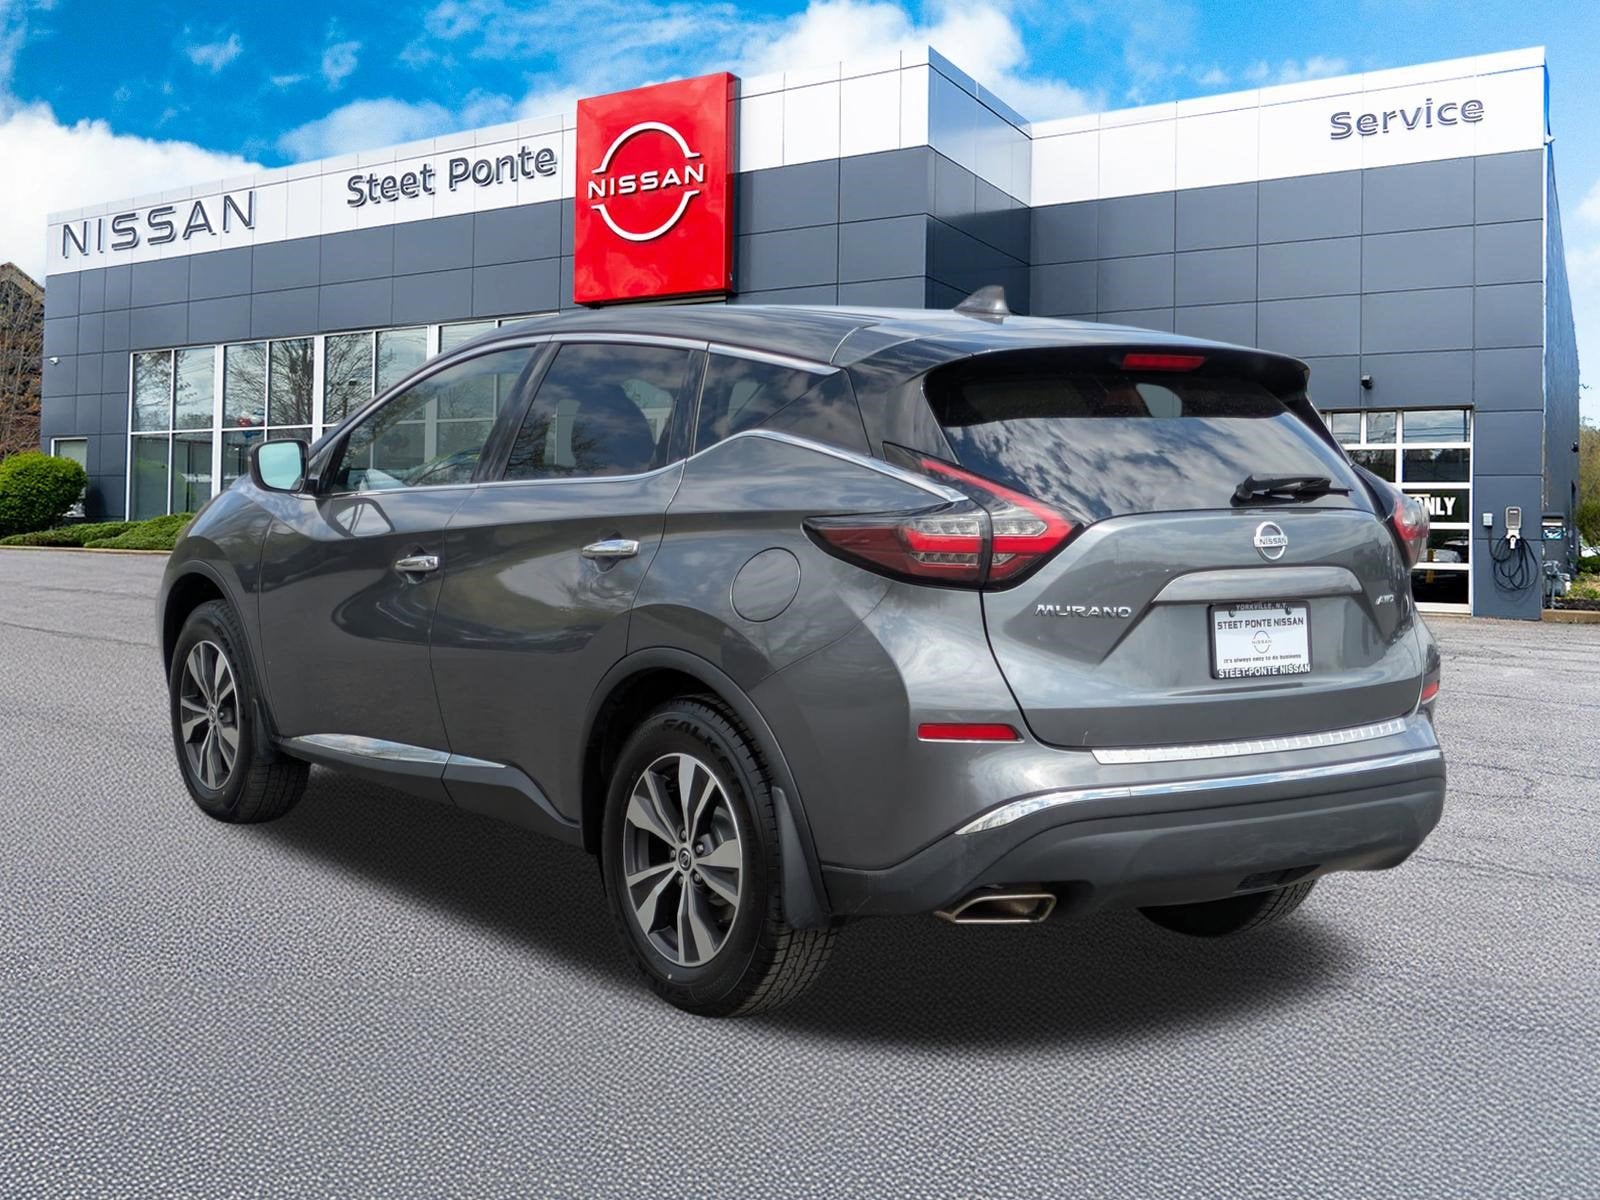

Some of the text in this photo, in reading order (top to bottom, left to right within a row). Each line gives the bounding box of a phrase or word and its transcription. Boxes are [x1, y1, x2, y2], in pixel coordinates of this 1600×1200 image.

[1330, 98, 1485, 140] Service
[347, 145, 558, 208] Steet Ponte
[586, 163, 706, 201] NISSAN
[62, 190, 256, 260] NISSAN
[1259, 536, 1287, 546] NISSAN
[1035, 603, 1132, 618] MURANO
[1217, 617, 1304, 630] STEET PONTE NISSAN
[1280, 663, 1311, 676] NISSAN
